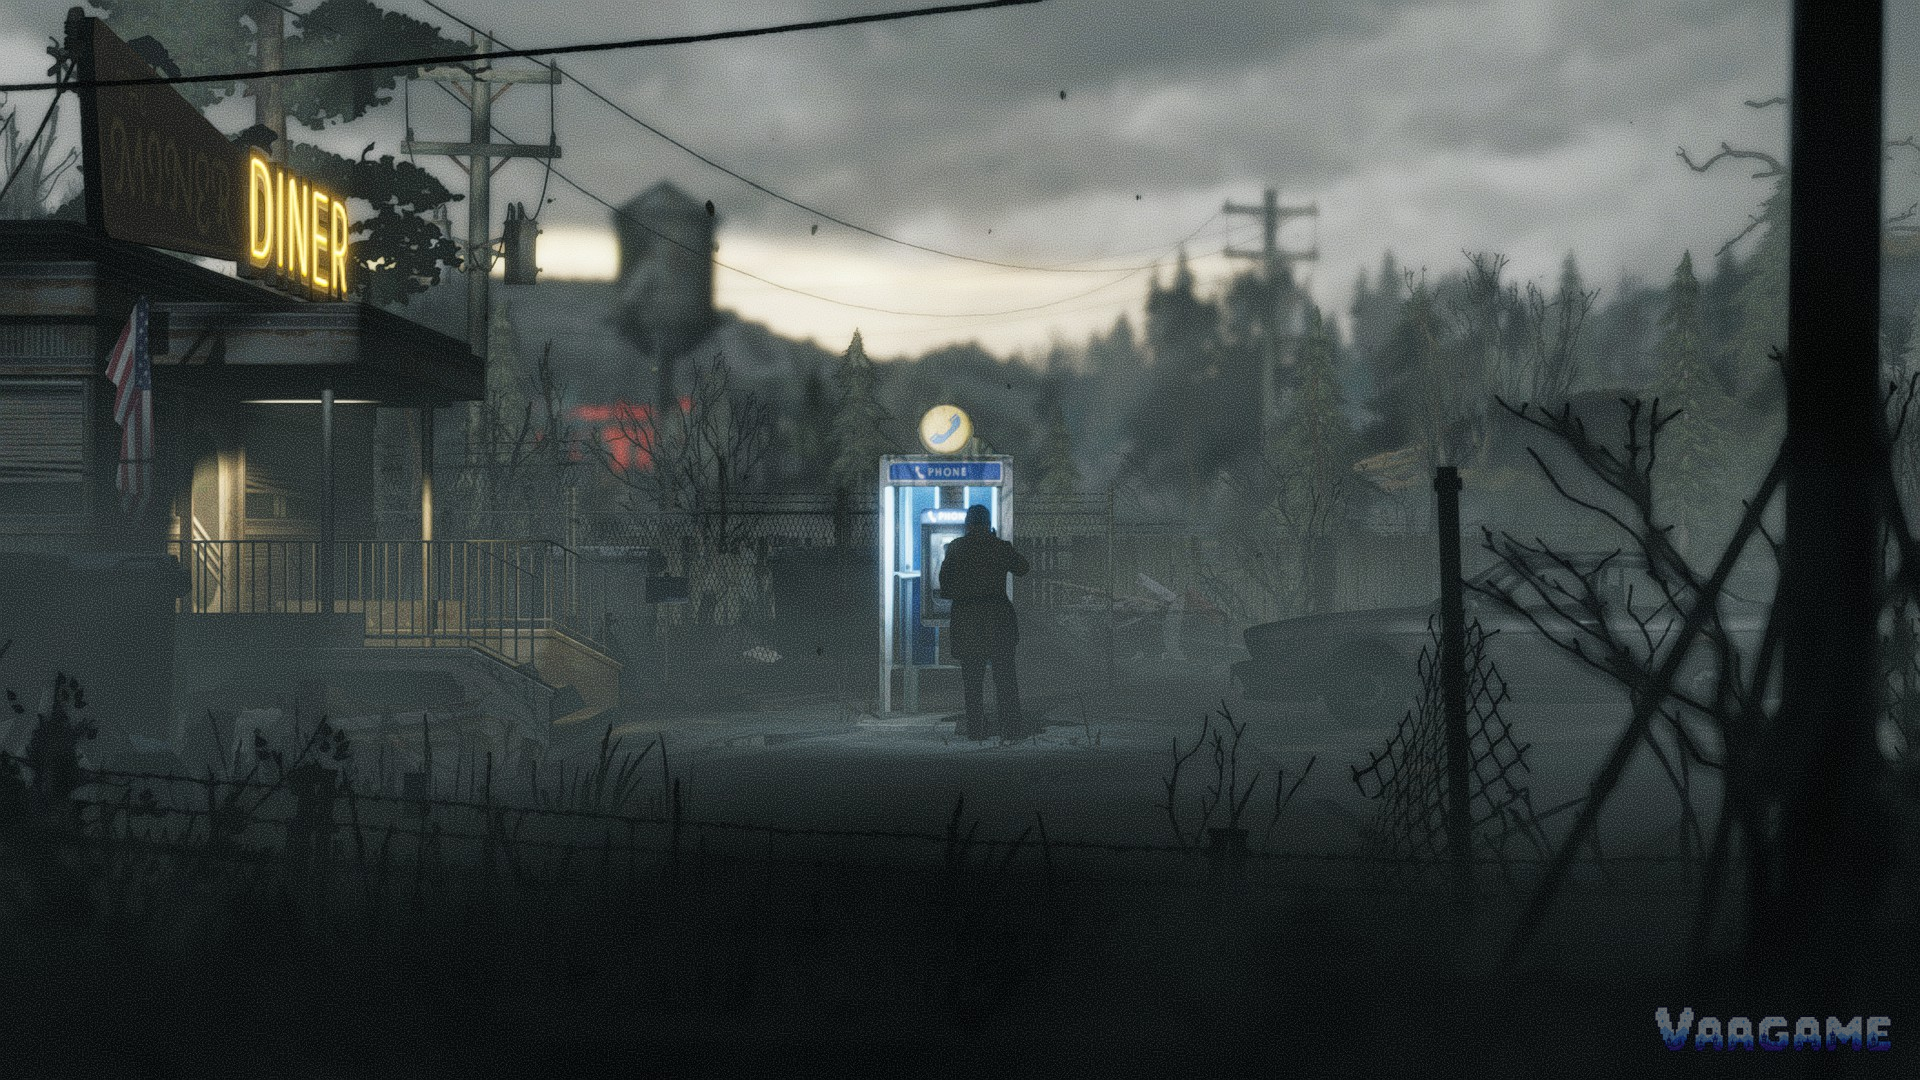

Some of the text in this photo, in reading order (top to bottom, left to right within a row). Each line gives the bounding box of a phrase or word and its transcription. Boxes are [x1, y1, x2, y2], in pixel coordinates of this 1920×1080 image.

[250, 156, 348, 293] DINER
[927, 466, 967, 477] PHONE
[938, 511, 967, 521] PHON
